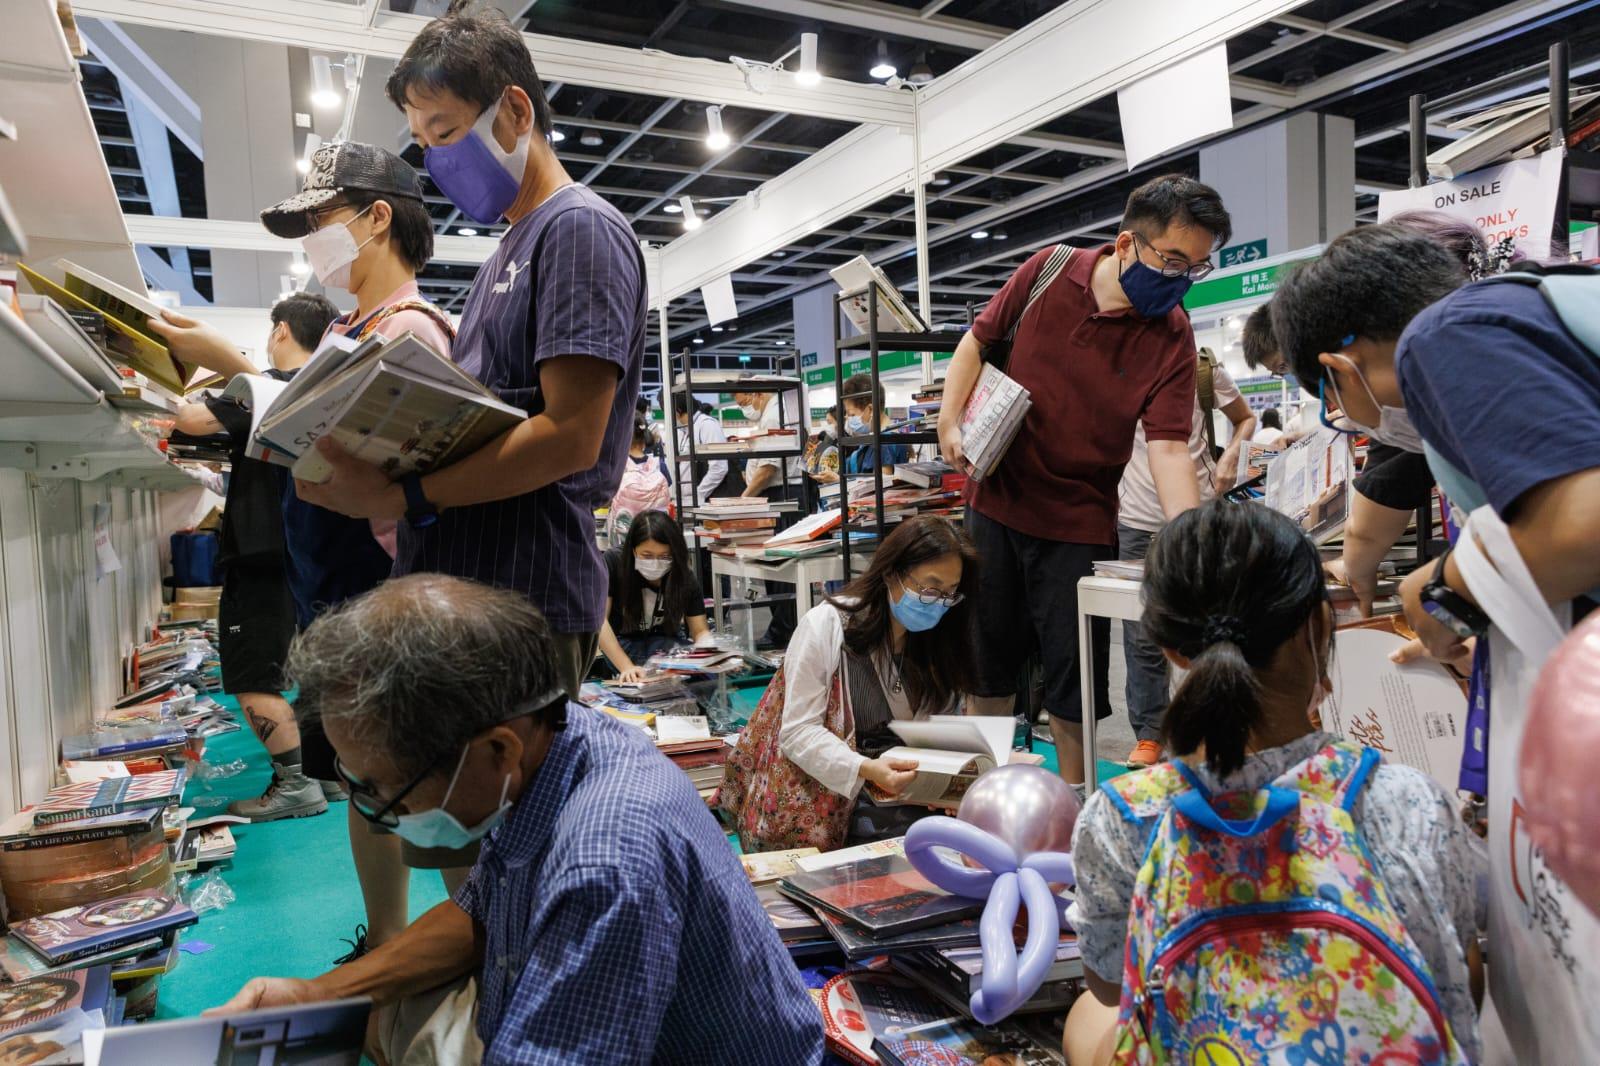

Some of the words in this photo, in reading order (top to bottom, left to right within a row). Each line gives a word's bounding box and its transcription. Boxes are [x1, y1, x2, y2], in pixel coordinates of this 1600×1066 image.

[1435, 193, 1455, 209] ON
[1460, 181, 1501, 202] SALE
[1476, 208, 1518, 229] ONLY
[1487, 225, 1529, 246] OOKS
[37, 804, 117, 825] Samarkand
[30, 840, 43, 848] MY
[62, 835, 74, 843] ON
[82, 831, 105, 840] PLATE
